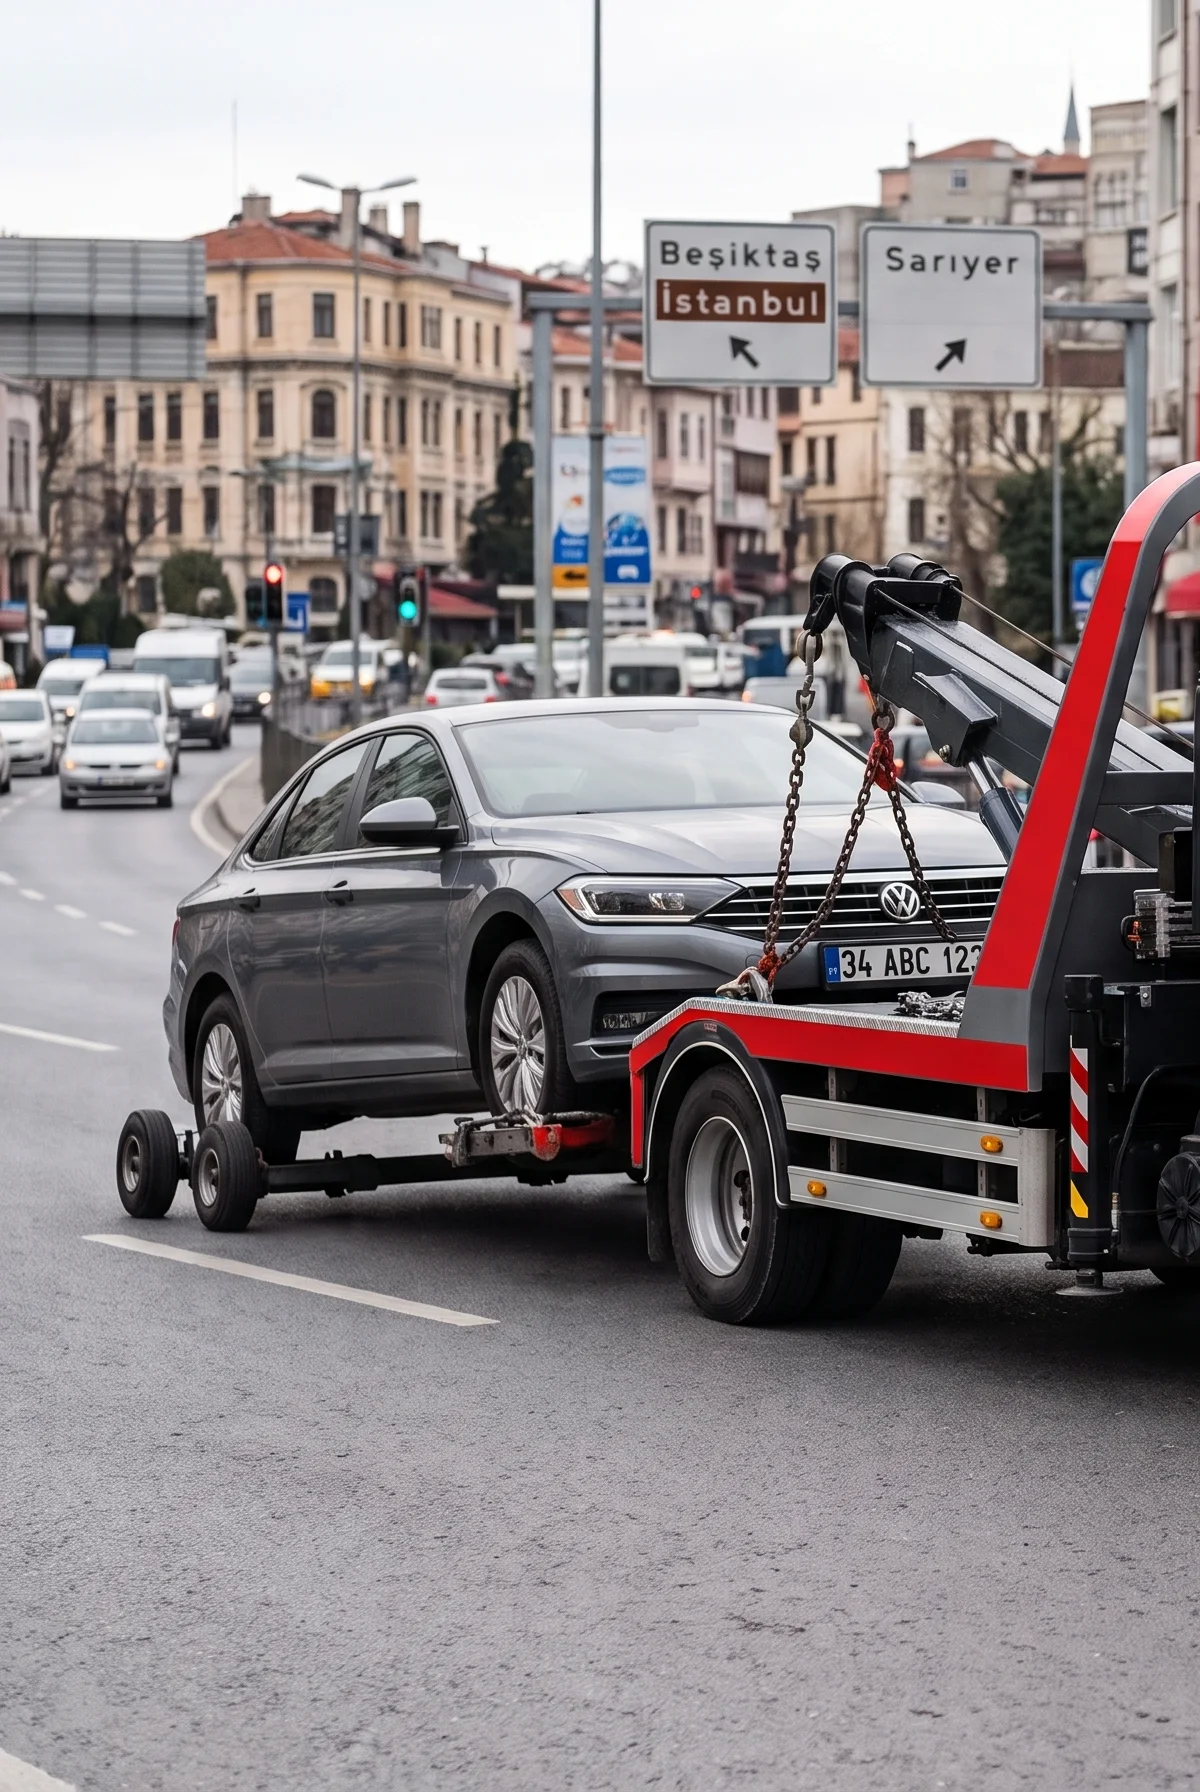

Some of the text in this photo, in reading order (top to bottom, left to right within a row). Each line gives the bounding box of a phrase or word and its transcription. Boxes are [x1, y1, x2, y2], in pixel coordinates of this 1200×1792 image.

[660, 240, 822, 274] Beşiktaş
[886, 246, 1019, 280] Sarıyer
[661, 282, 819, 316] İstanbul
[841, 949, 872, 979] 34
[884, 947, 930, 977] ABC
